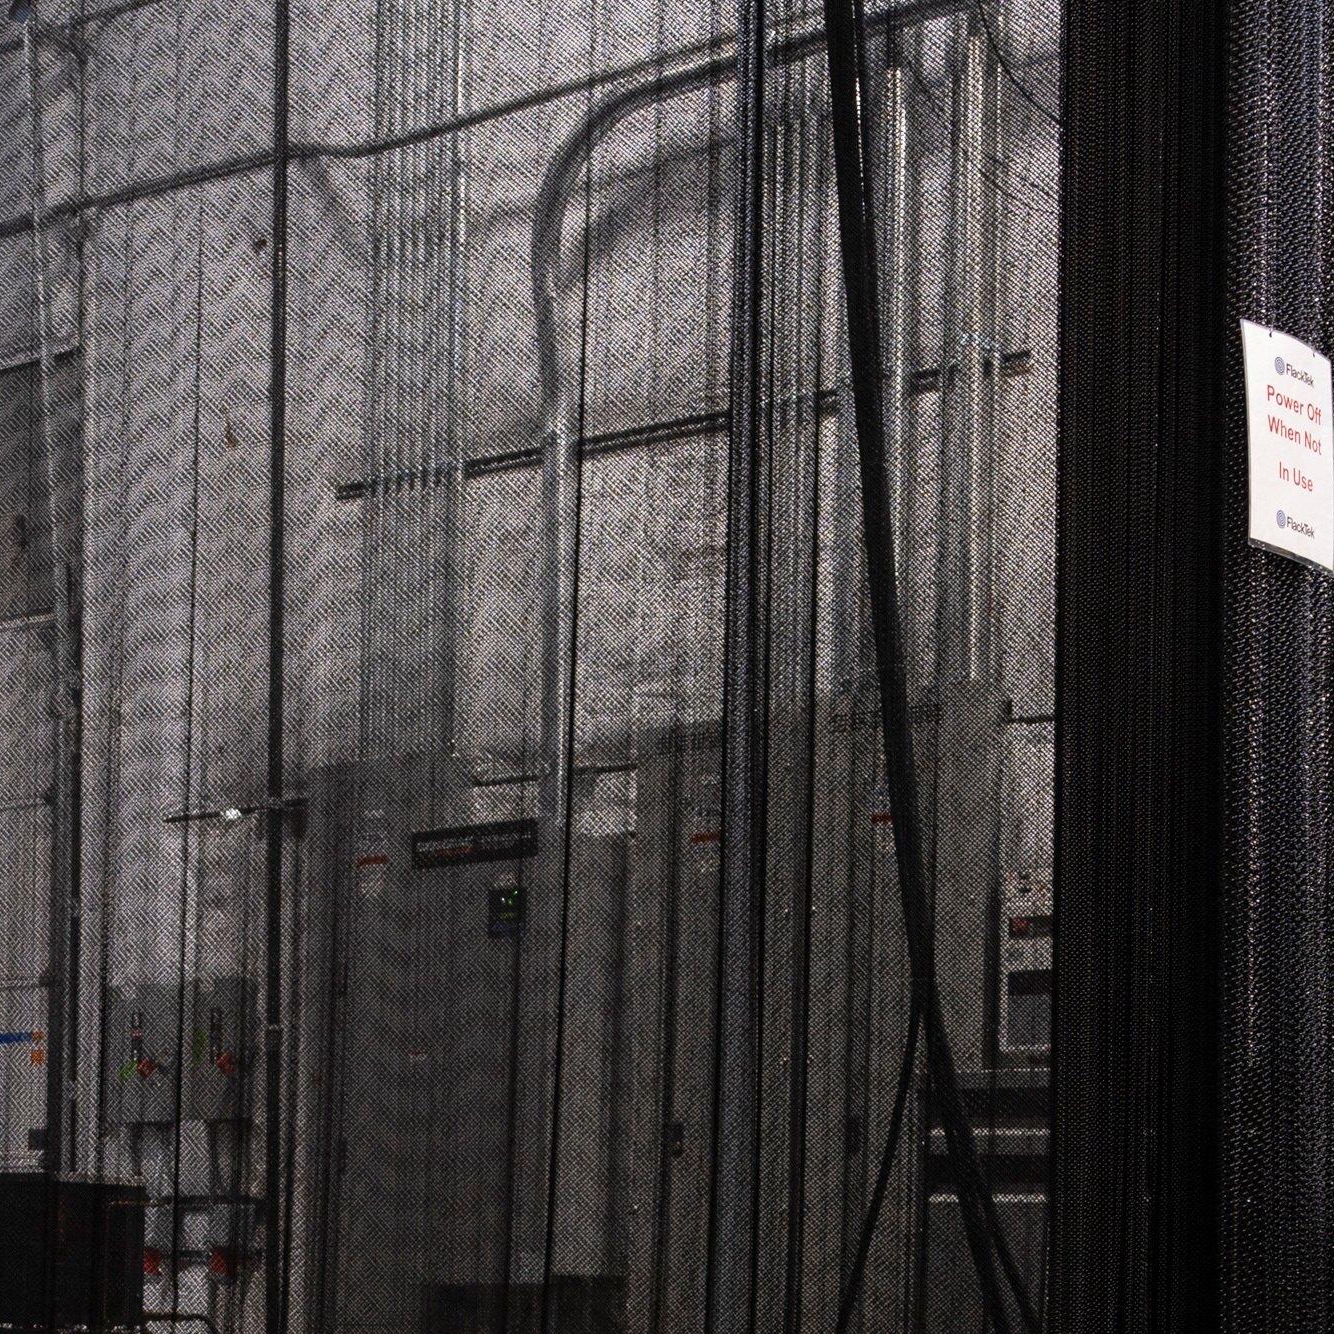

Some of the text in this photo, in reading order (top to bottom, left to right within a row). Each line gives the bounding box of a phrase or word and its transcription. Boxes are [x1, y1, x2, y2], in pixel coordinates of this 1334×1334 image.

[1286, 363, 1315, 388] FlackTek
[1267, 384, 1322, 425] Power Off
[1267, 414, 1322, 456] When Not
[1279, 461, 1314, 492] In Use
[1286, 516, 1315, 540] FlackTek
